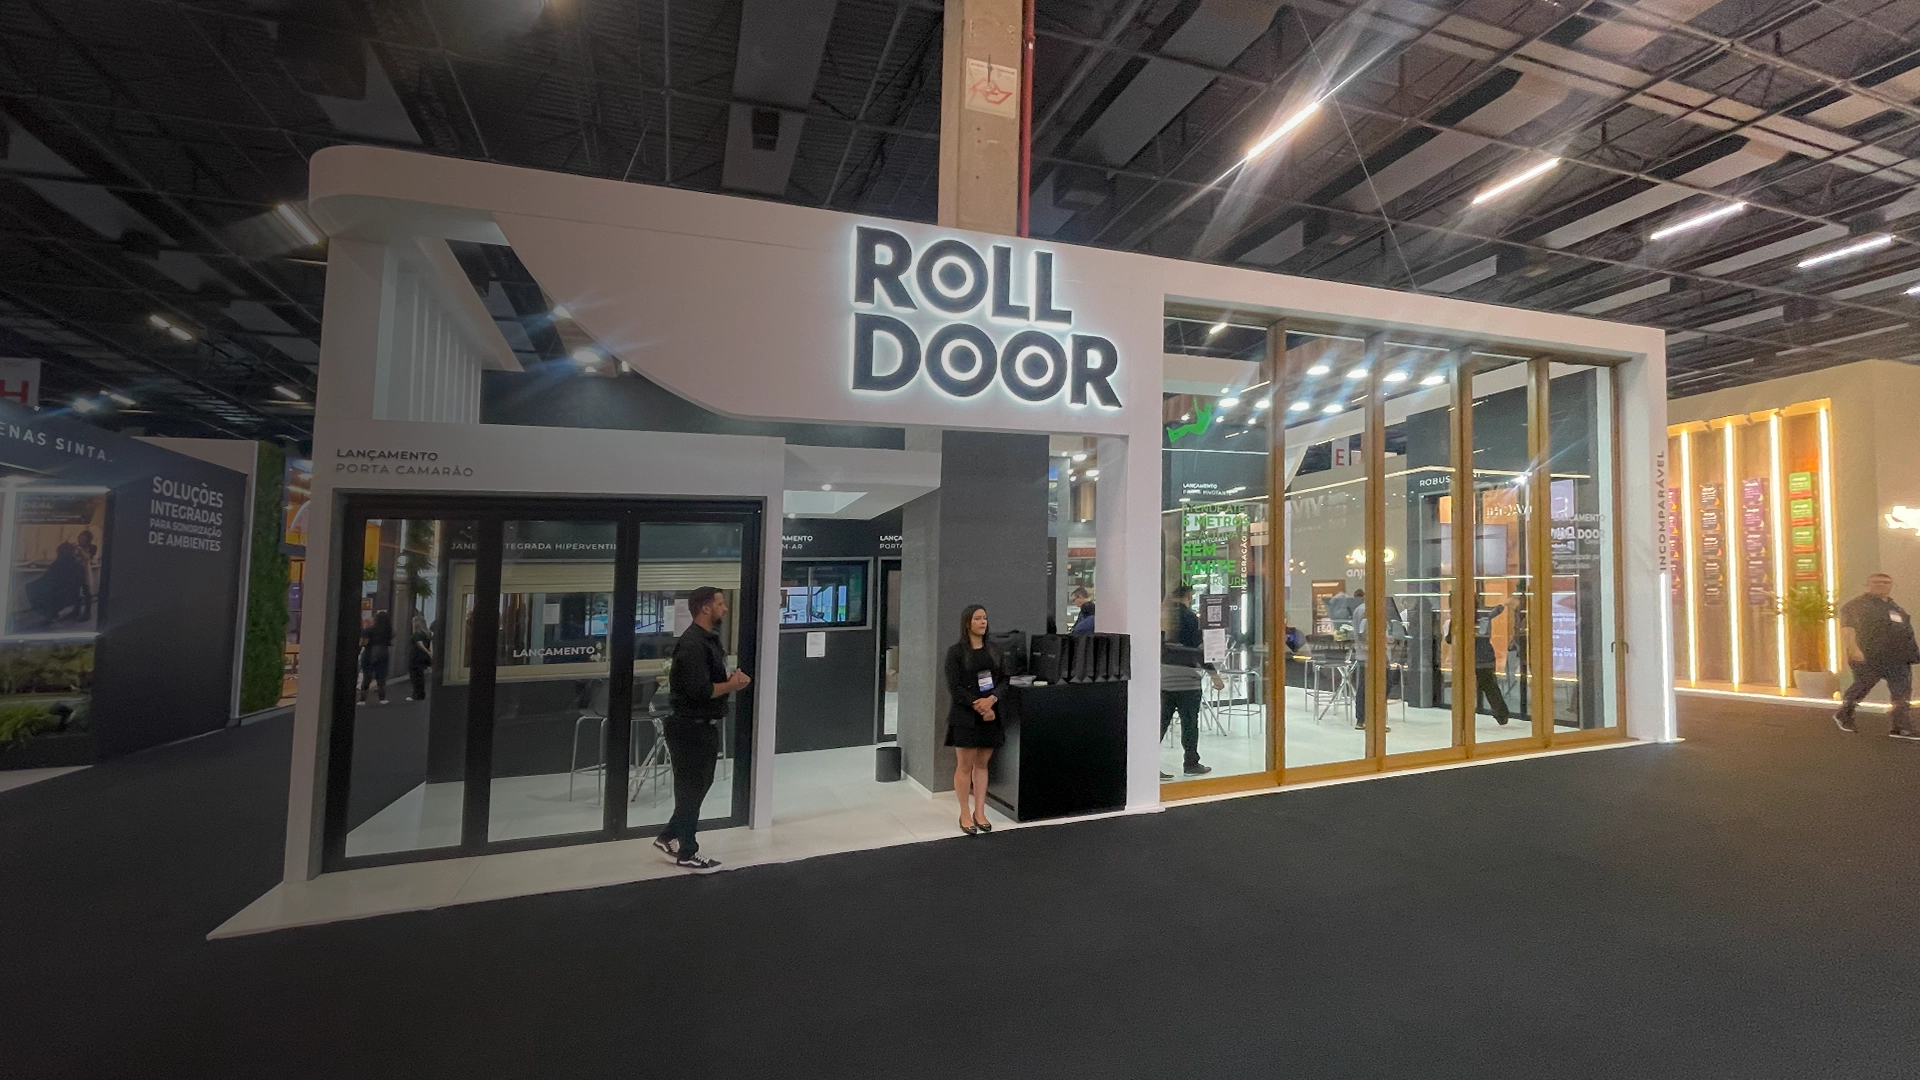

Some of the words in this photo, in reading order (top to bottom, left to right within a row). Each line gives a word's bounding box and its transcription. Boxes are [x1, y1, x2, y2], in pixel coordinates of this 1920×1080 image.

[854, 225, 1072, 325] ROLL
[852, 312, 1122, 408] DOOR
[336, 448, 438, 461] LANÇAMENTO
[335, 462, 389, 475] PORTA
[395, 463, 474, 477] CAMARÃO
[1420, 475, 1452, 487] ROBUS
[153, 475, 224, 508] SOLUÇÕES
[151, 499, 223, 526] INTEGRADAS
[1656, 451, 1667, 570] INCOMPARÁVEL
[150, 518, 172, 531] PARA
[172, 520, 222, 538] SONORIZAÇÃO
[1194, 515, 1251, 528] METROS
[149, 531, 164, 545] DE
[166, 533, 221, 552] AMBIENTES
[450, 542, 477, 550] JANE
[504, 542, 551, 550] TEGRADA
[555, 542, 617, 550] HIPERVENTIL
[1182, 543, 1217, 557] SEM
[1182, 560, 1236, 574] LIMITE
[512, 645, 596, 659] LANÇAMENTO
